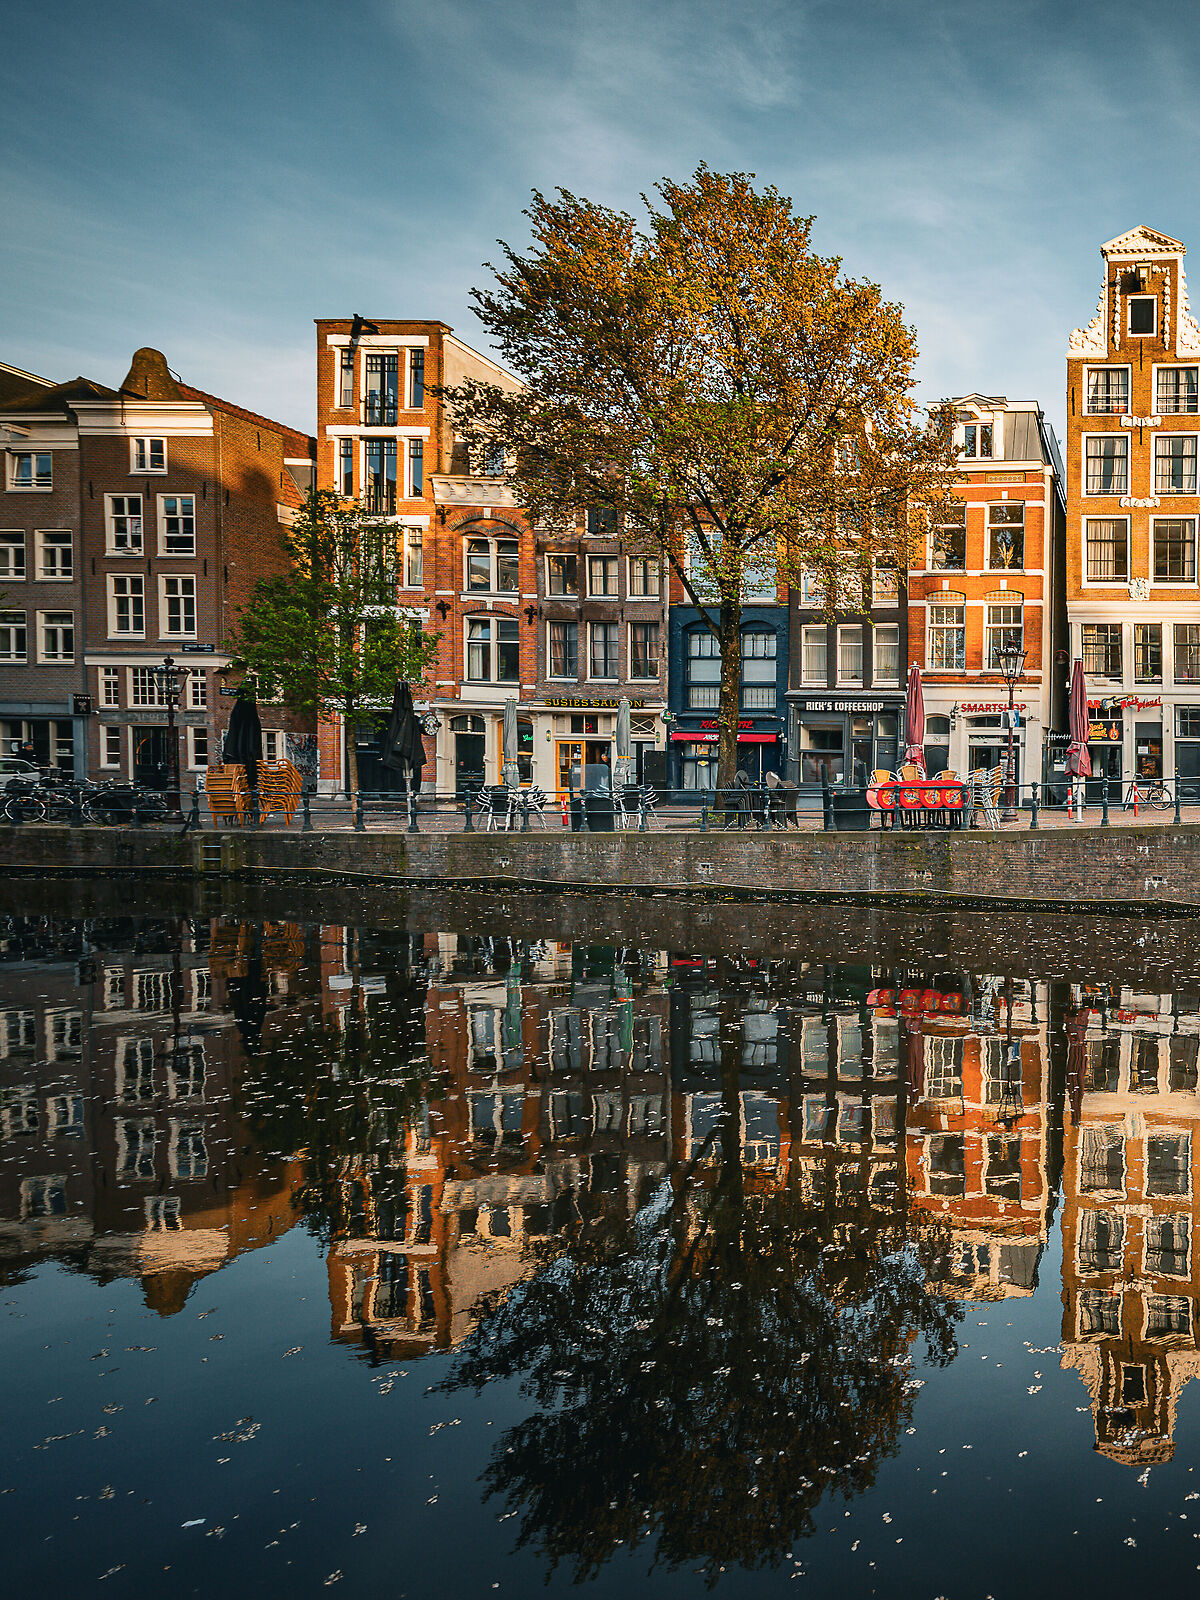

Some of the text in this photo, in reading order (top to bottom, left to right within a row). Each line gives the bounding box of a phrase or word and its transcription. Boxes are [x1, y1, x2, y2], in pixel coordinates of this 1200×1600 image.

[544, 698, 589, 708] SUSIES
[806, 701, 884, 712] RICK'S COFFEESHOP
[1086, 700, 1101, 709] AR
